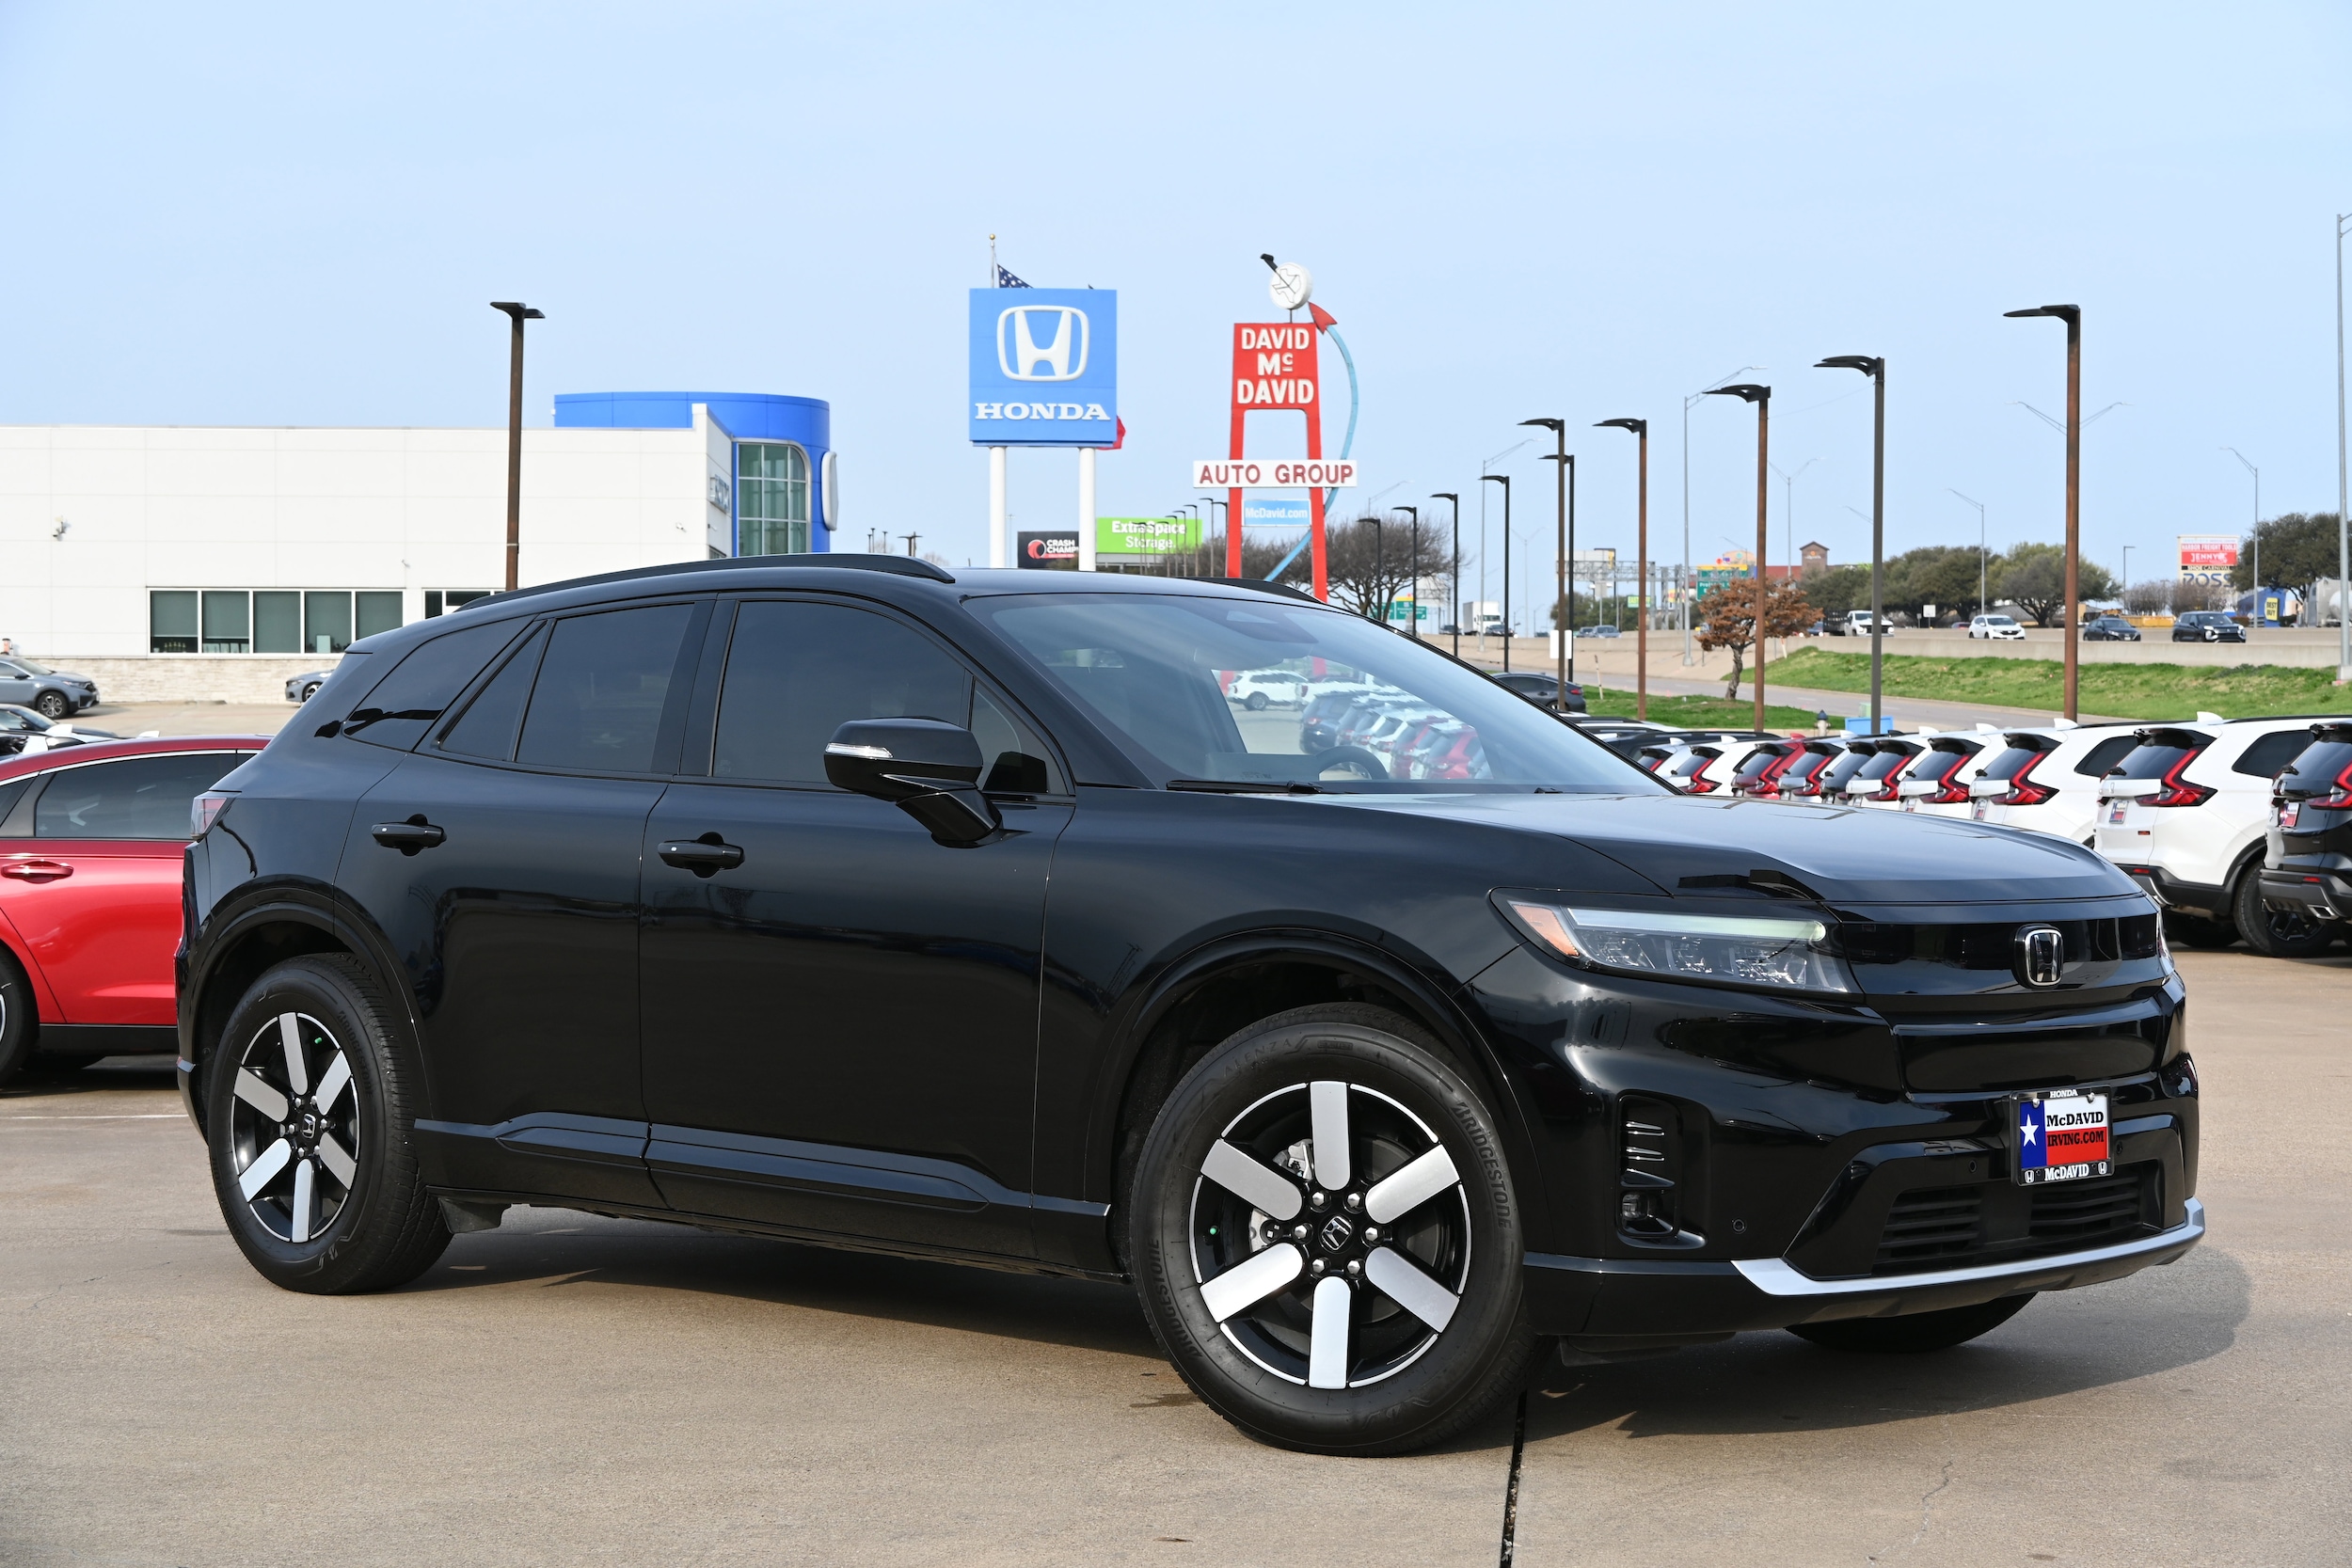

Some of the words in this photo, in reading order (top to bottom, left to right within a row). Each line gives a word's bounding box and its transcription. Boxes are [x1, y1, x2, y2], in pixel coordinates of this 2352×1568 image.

[1241, 327, 1310, 350] DAVID
[1237, 379, 1314, 404] DAVID
[975, 403, 1111, 420] HONDA
[1200, 465, 1261, 484] AUTO
[1275, 464, 1353, 484] GROUP
[1245, 508, 1308, 518] McDavid.com
[2049, 1089, 2078, 1099] HONDA
[2046, 1111, 2105, 1127] McDAVID
[2047, 1131, 2105, 1148] IRVING.COM
[1454, 1101, 1513, 1229] BRIDGESTONE
[2044, 1164, 2090, 1181] McDAVID
[1149, 1238, 1202, 1360] BRIDGESTONE
